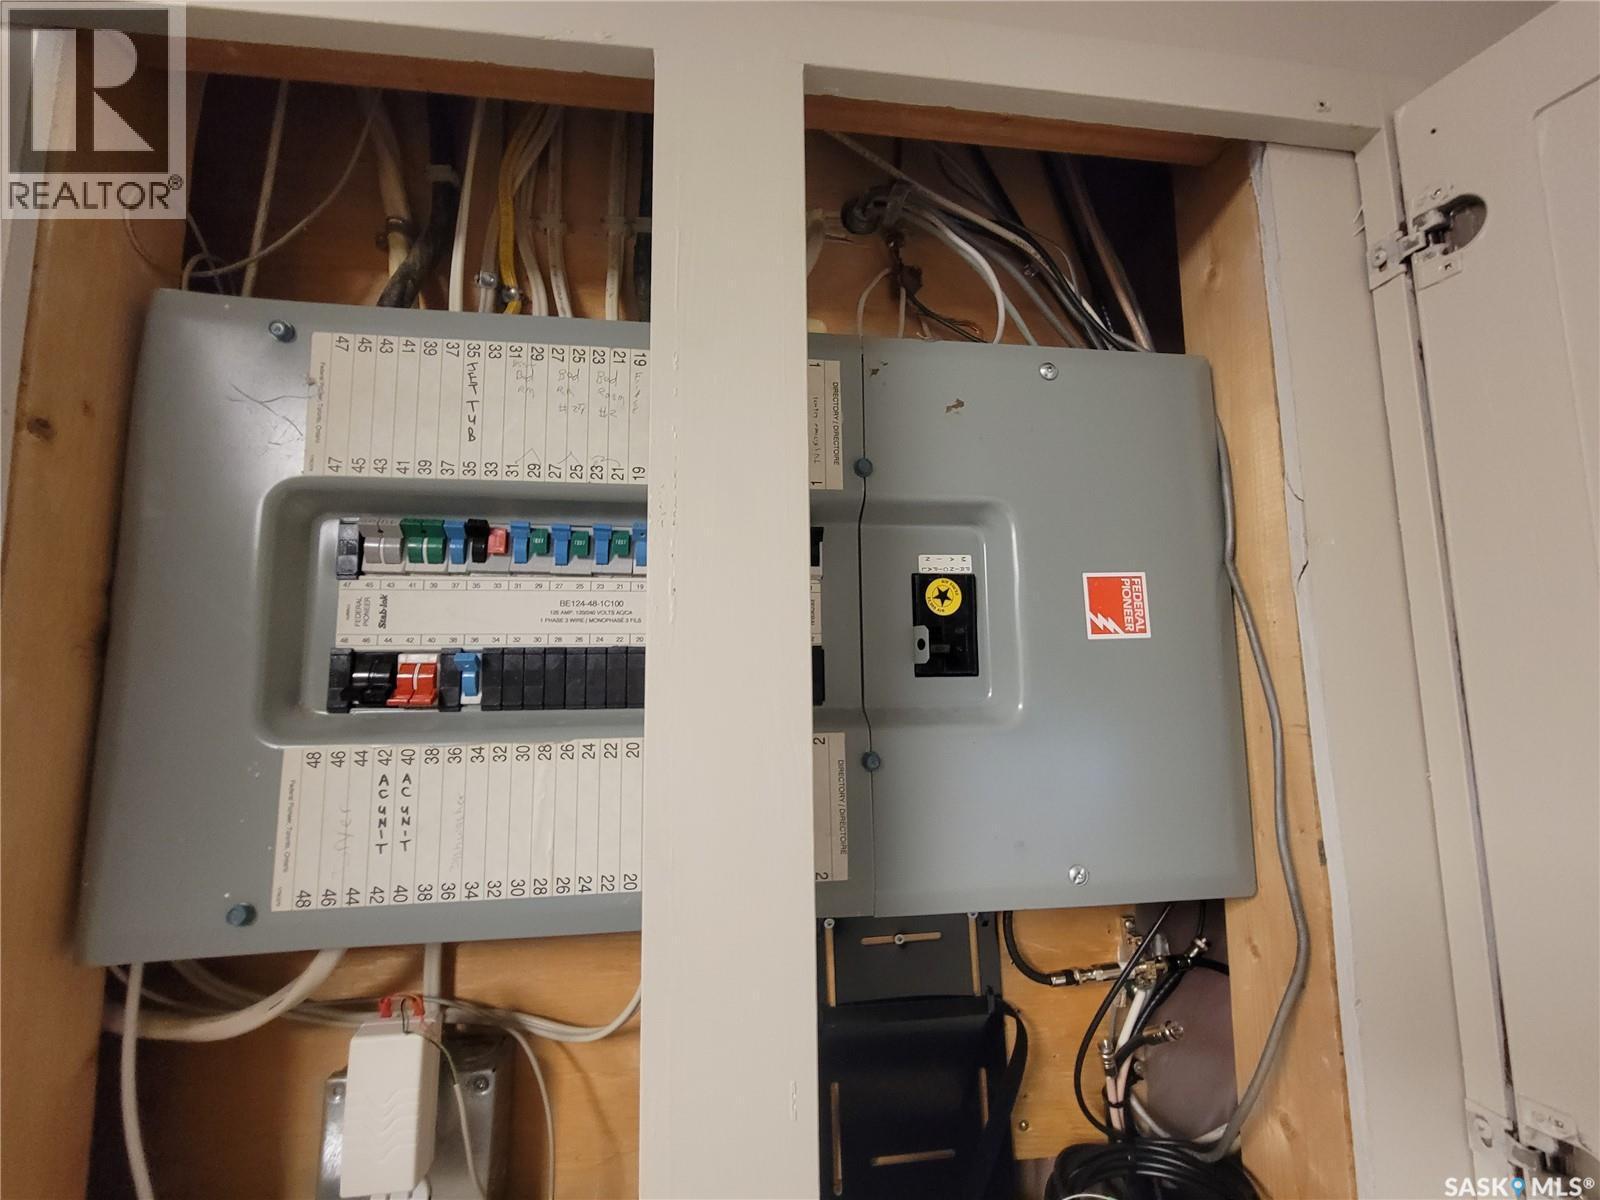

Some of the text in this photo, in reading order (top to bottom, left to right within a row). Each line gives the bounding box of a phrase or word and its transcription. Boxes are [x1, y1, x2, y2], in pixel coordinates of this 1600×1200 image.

[335, 335, 350, 353] 47
[357, 337, 372, 354] 45
[379, 338, 394, 355] 43
[401, 339, 417, 354] 41
[423, 340, 438, 357] 39
[445, 341, 460, 358] 37
[466, 343, 481, 359] 35
[488, 343, 503, 360] 33
[509, 344, 524, 360] 31
[530, 346, 545, 362] 29
[551, 347, 565, 363] 27
[572, 348, 586, 364] 25
[592, 349, 606, 365] 23
[613, 350, 627, 365] 21
[633, 352, 648, 367] 19
[327, 456, 343, 473] 47
[351, 457, 366, 474] 45
[373, 458, 388, 474] 43
[396, 460, 410, 476] 41
[417, 459, 433, 475] 39
[440, 460, 455, 476] 37
[462, 461, 477, 477] 35
[483, 461, 499, 477] 33
[505, 463, 519, 479] 31
[527, 463, 542, 479] 29
[547, 463, 562, 480] 27
[569, 464, 584, 480] 25
[589, 464, 604, 480] 23
[610, 466, 625, 482] 21
[631, 465, 646, 481] 19
[354, 596, 363, 627] FEDERAL
[362, 596, 371, 627] PIONEER
[559, 600, 624, 608] BE124-48-1C100
[1120, 577, 1135, 632] PIONEER
[1130, 577, 1145, 633] FEDERAL
[813, 737, 826, 745] 2
[378, 750, 392, 766] 42
[401, 749, 415, 765] 40
[424, 749, 439, 764] 38
[448, 748, 462, 763] 36
[471, 747, 484, 763] 34
[493, 747, 507, 762] 32
[516, 746, 530, 761] 30
[538, 745, 551, 760] 28
[560, 745, 574, 760] 26
[582, 744, 595, 759] 24
[604, 743, 617, 758] 22
[626, 743, 639, 758] 20
[306, 752, 321, 768] 48
[331, 751, 345, 767] 46
[354, 751, 368, 767] 44
[378, 773, 390, 799] AC
[400, 772, 412, 798] AC
[838, 759, 846, 802] DIRECTORY
[839, 808, 848, 855] DIRECTOIRE
[579, 876, 592, 892] 24
[601, 875, 615, 891] 22
[624, 873, 639, 889] 20
[815, 871, 829, 881] 2
[418, 884, 433, 900] 38
[441, 883, 456, 899] 36
[465, 882, 479, 899] 34
[488, 881, 501, 898] 32
[511, 880, 525, 896] 30
[534, 879, 547, 895] 28
[556, 877, 570, 893] 26
[296, 890, 311, 907] 48
[321, 889, 336, 906] 46
[346, 888, 360, 904] 44
[370, 886, 384, 903] 42
[393, 885, 408, 902] 40
